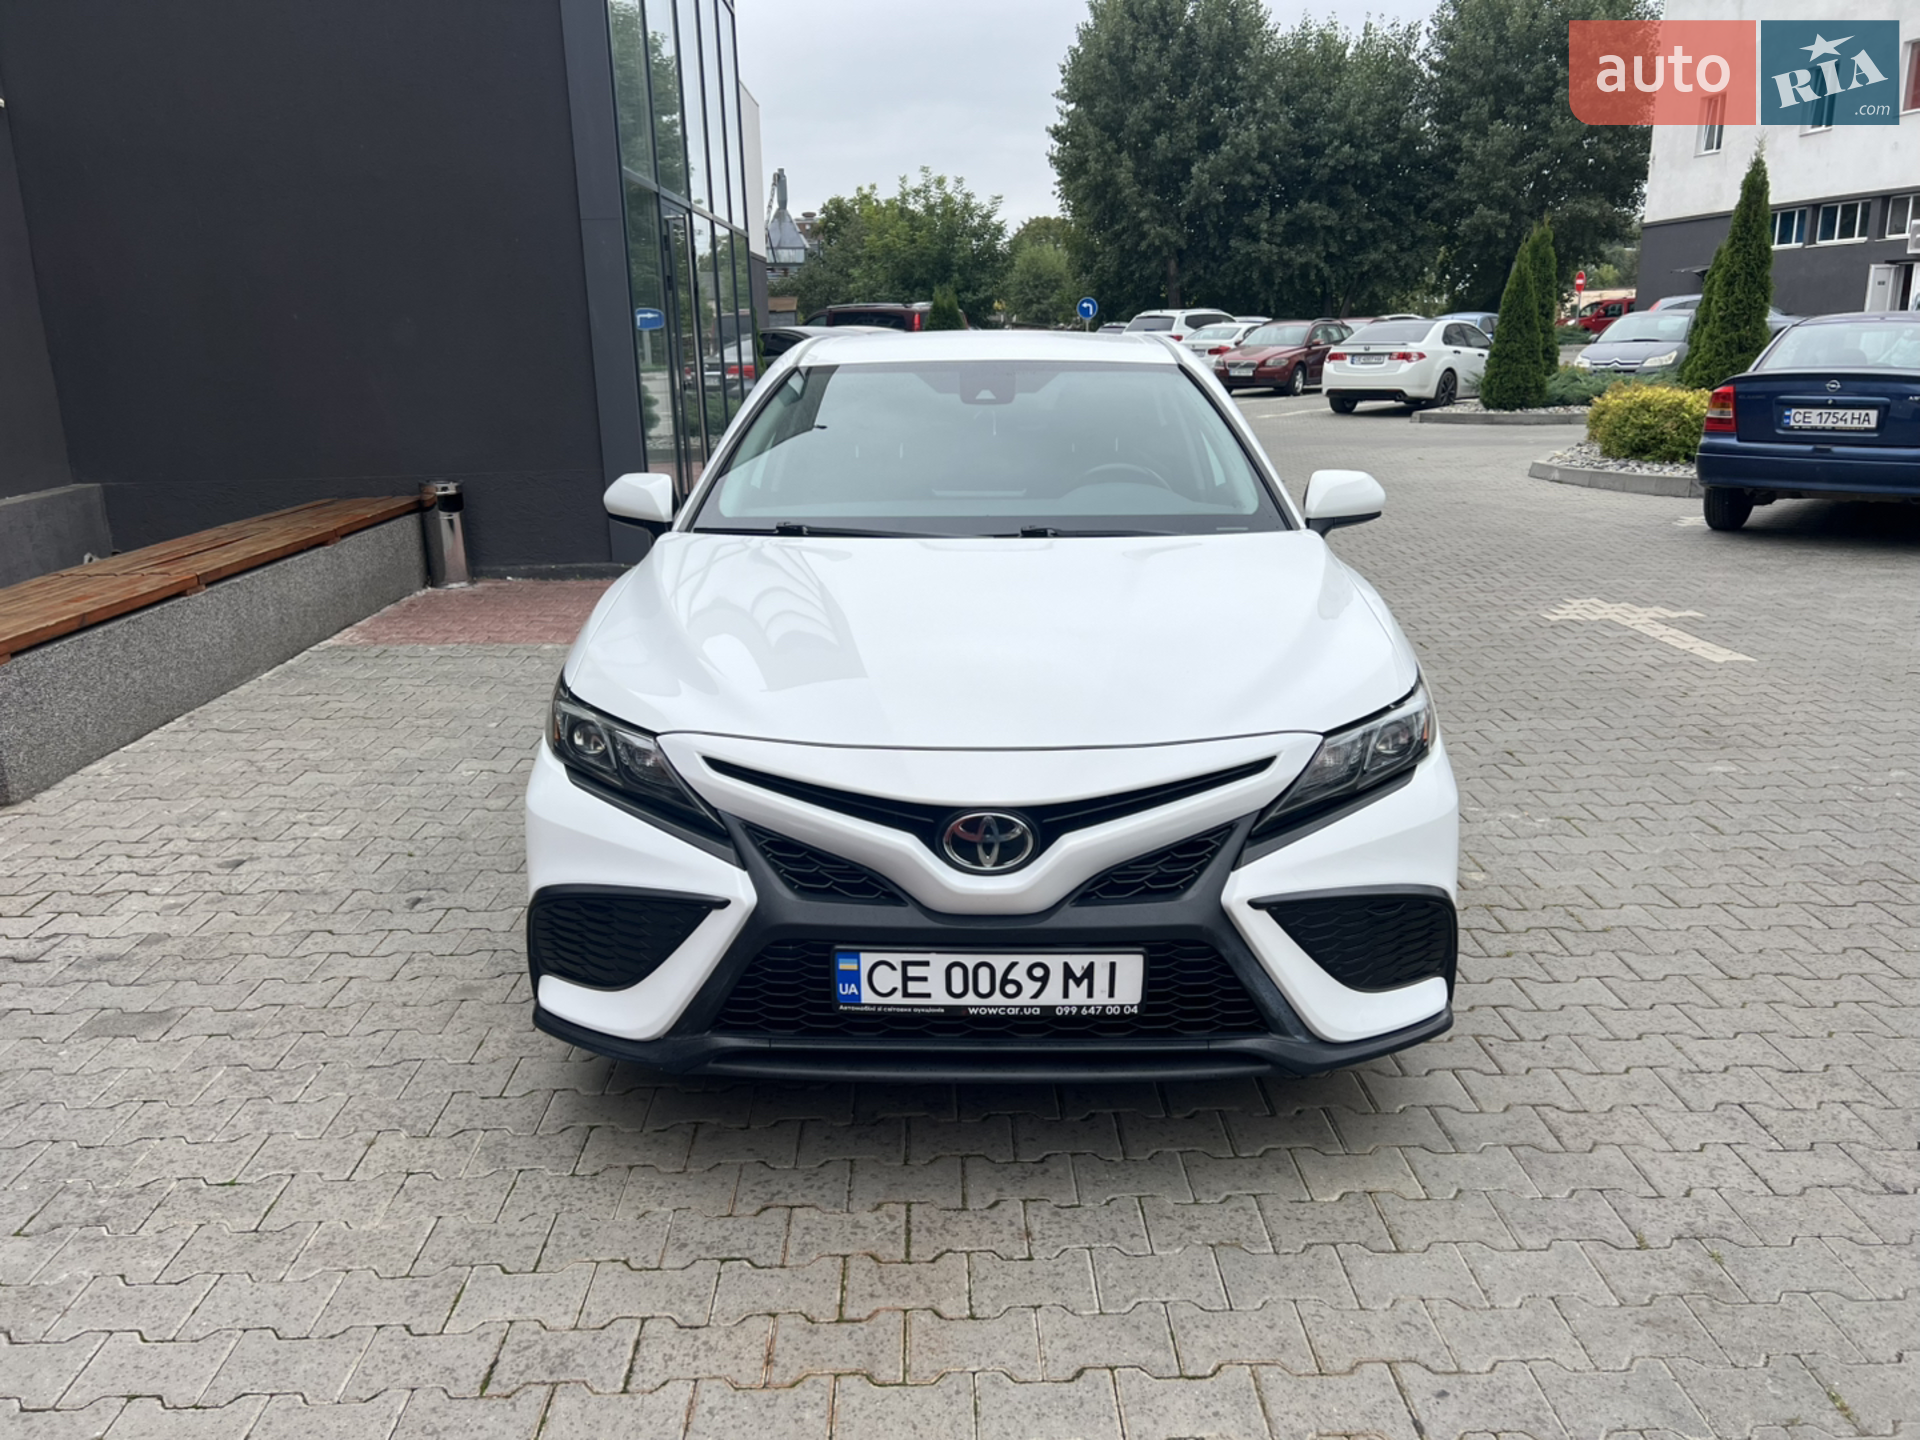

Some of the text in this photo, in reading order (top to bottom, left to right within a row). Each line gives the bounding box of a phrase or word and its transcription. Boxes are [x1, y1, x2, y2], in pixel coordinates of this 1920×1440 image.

[1792, 411, 1871, 425] CE 1754 HA
[867, 959, 1117, 999] CE 0069 MI
[839, 983, 859, 995] UA
[967, 1005, 1139, 1016] wowcar.ua 099 647 00 04
